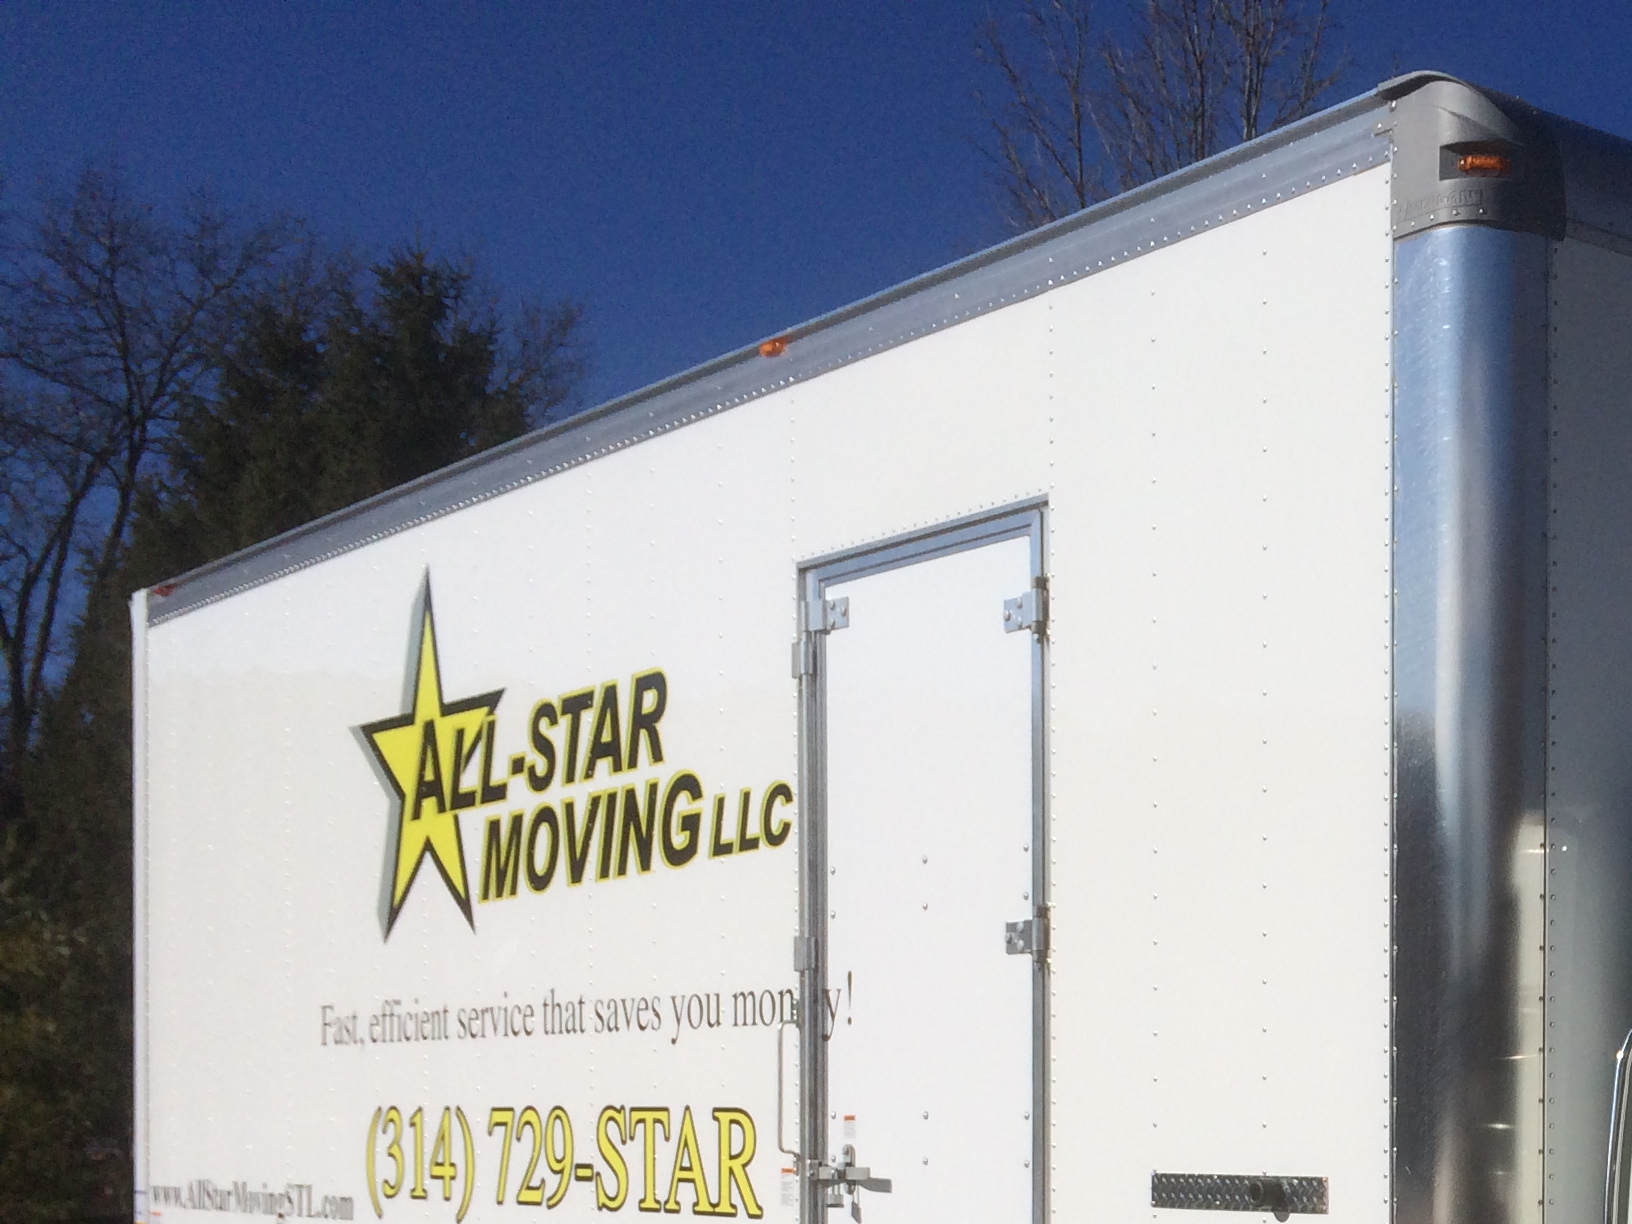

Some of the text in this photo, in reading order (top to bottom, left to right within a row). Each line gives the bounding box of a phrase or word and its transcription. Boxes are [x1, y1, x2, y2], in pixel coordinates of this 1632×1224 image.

[408, 667, 668, 822] ALL-STAR
[478, 769, 794, 904] MOVING LLC
[320, 971, 853, 1049] Fast, efficient service that saves you mony!
[366, 1104, 763, 1224] (314) 729-STAR
